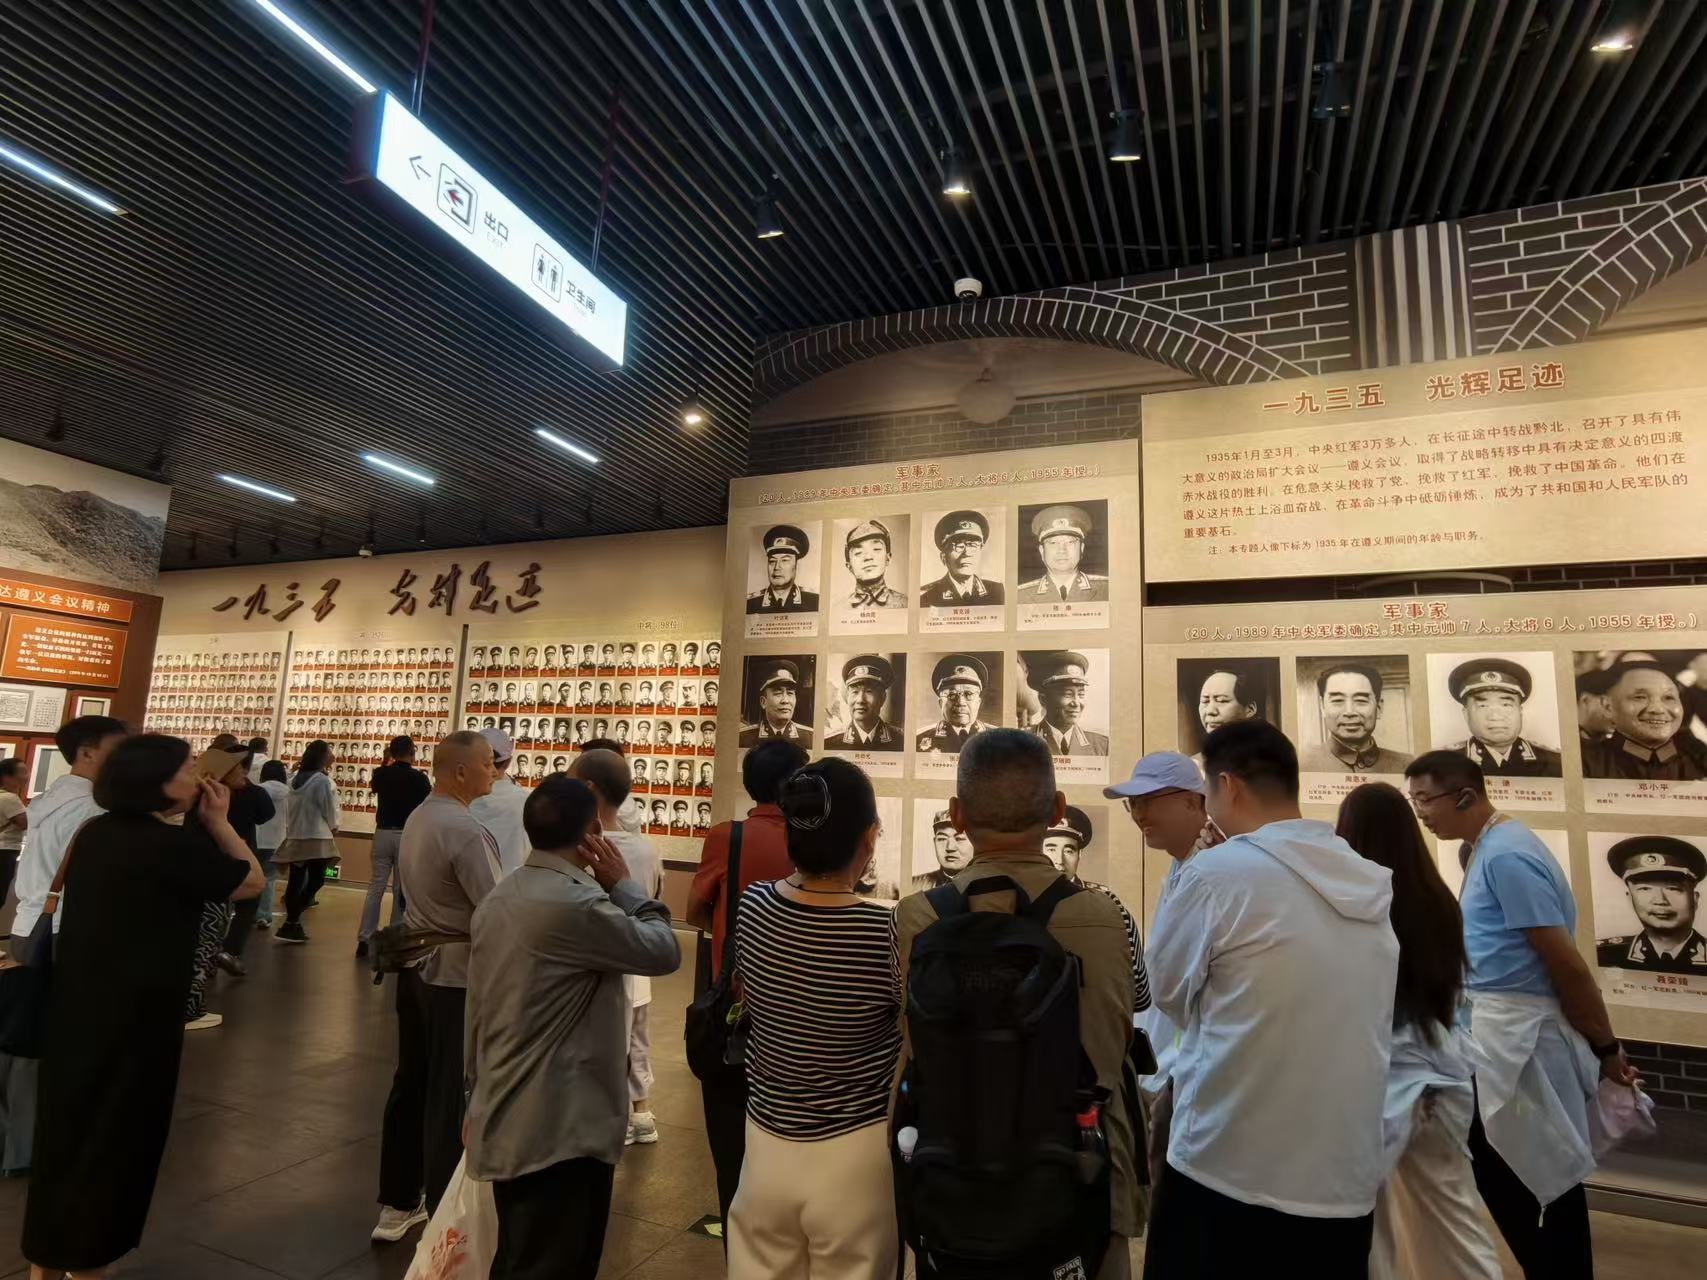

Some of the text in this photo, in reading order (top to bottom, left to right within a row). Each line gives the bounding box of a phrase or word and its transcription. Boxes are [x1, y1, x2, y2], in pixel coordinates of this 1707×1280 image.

[484, 211, 509, 242] 出口
[566, 280, 596, 315] 卫生间
[1263, 363, 1565, 415] 一九三五 光辉足迹
[896, 463, 941, 480] 军事家
[1184, 525, 1237, 539] 重要基石。
[212, 560, 542, 622] 一九三五 光辉足迹
[1383, 602, 1448, 619] 军事家
[1639, 783, 1669, 791] 邓小平
